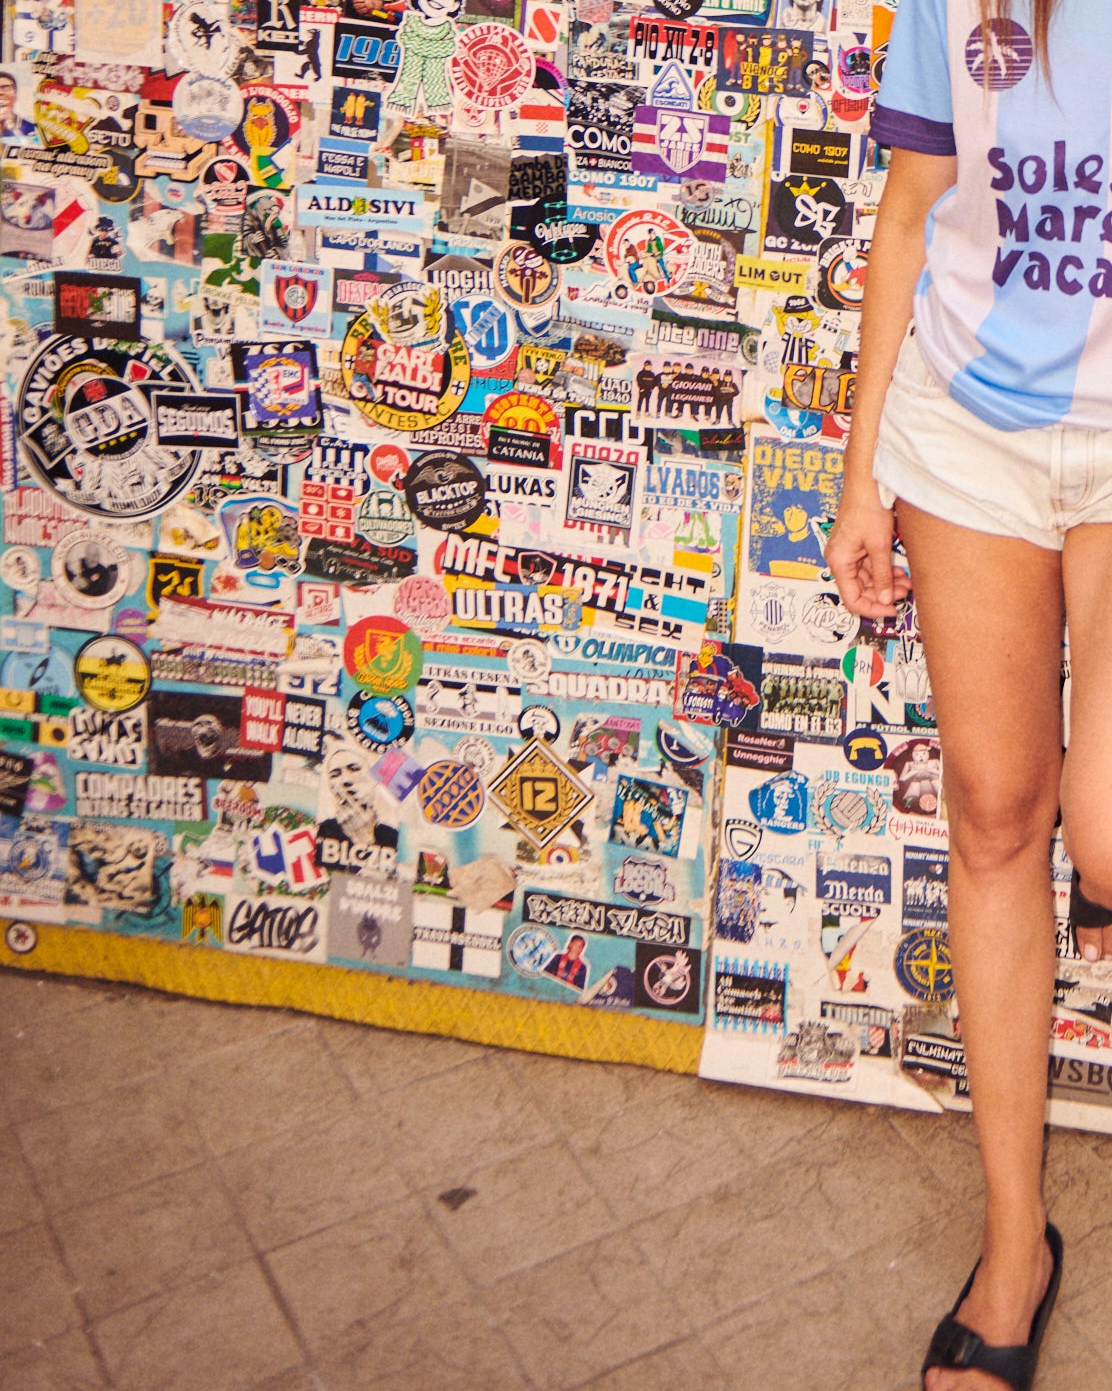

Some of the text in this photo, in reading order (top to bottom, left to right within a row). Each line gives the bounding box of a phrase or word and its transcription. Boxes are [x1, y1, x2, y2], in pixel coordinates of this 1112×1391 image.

[634, 22, 660, 59] PIO
[568, 125, 631, 154] COMO
[569, 172, 656, 190] COMO 1907
[572, 206, 616, 223] Arosio
[739, 264, 767, 279] LIM
[377, 346, 435, 369] GARI
[383, 388, 439, 414] TOUR
[492, 445, 545, 462] CATANIA
[416, 481, 478, 504] BLACKTOP
[487, 474, 555, 497] LUKAS
[764, 468, 836, 491] VIVE
[443, 533, 630, 611] MFC 1871
[456, 589, 564, 624] ULTRAS
[614, 614, 683, 640] SEX
[582, 639, 676, 666] OLIMPICA
[526, 671, 670, 706] SQUADRA
[244, 690, 283, 719] YOU'LL
[286, 700, 324, 728] NEVER
[246, 719, 281, 747] WALK
[284, 730, 322, 755] ALONE
[75, 774, 202, 802] COMPADRES
[521, 778, 559, 812] 12
[761, 818, 804, 830] RANGERS
[824, 880, 885, 902] Merda
